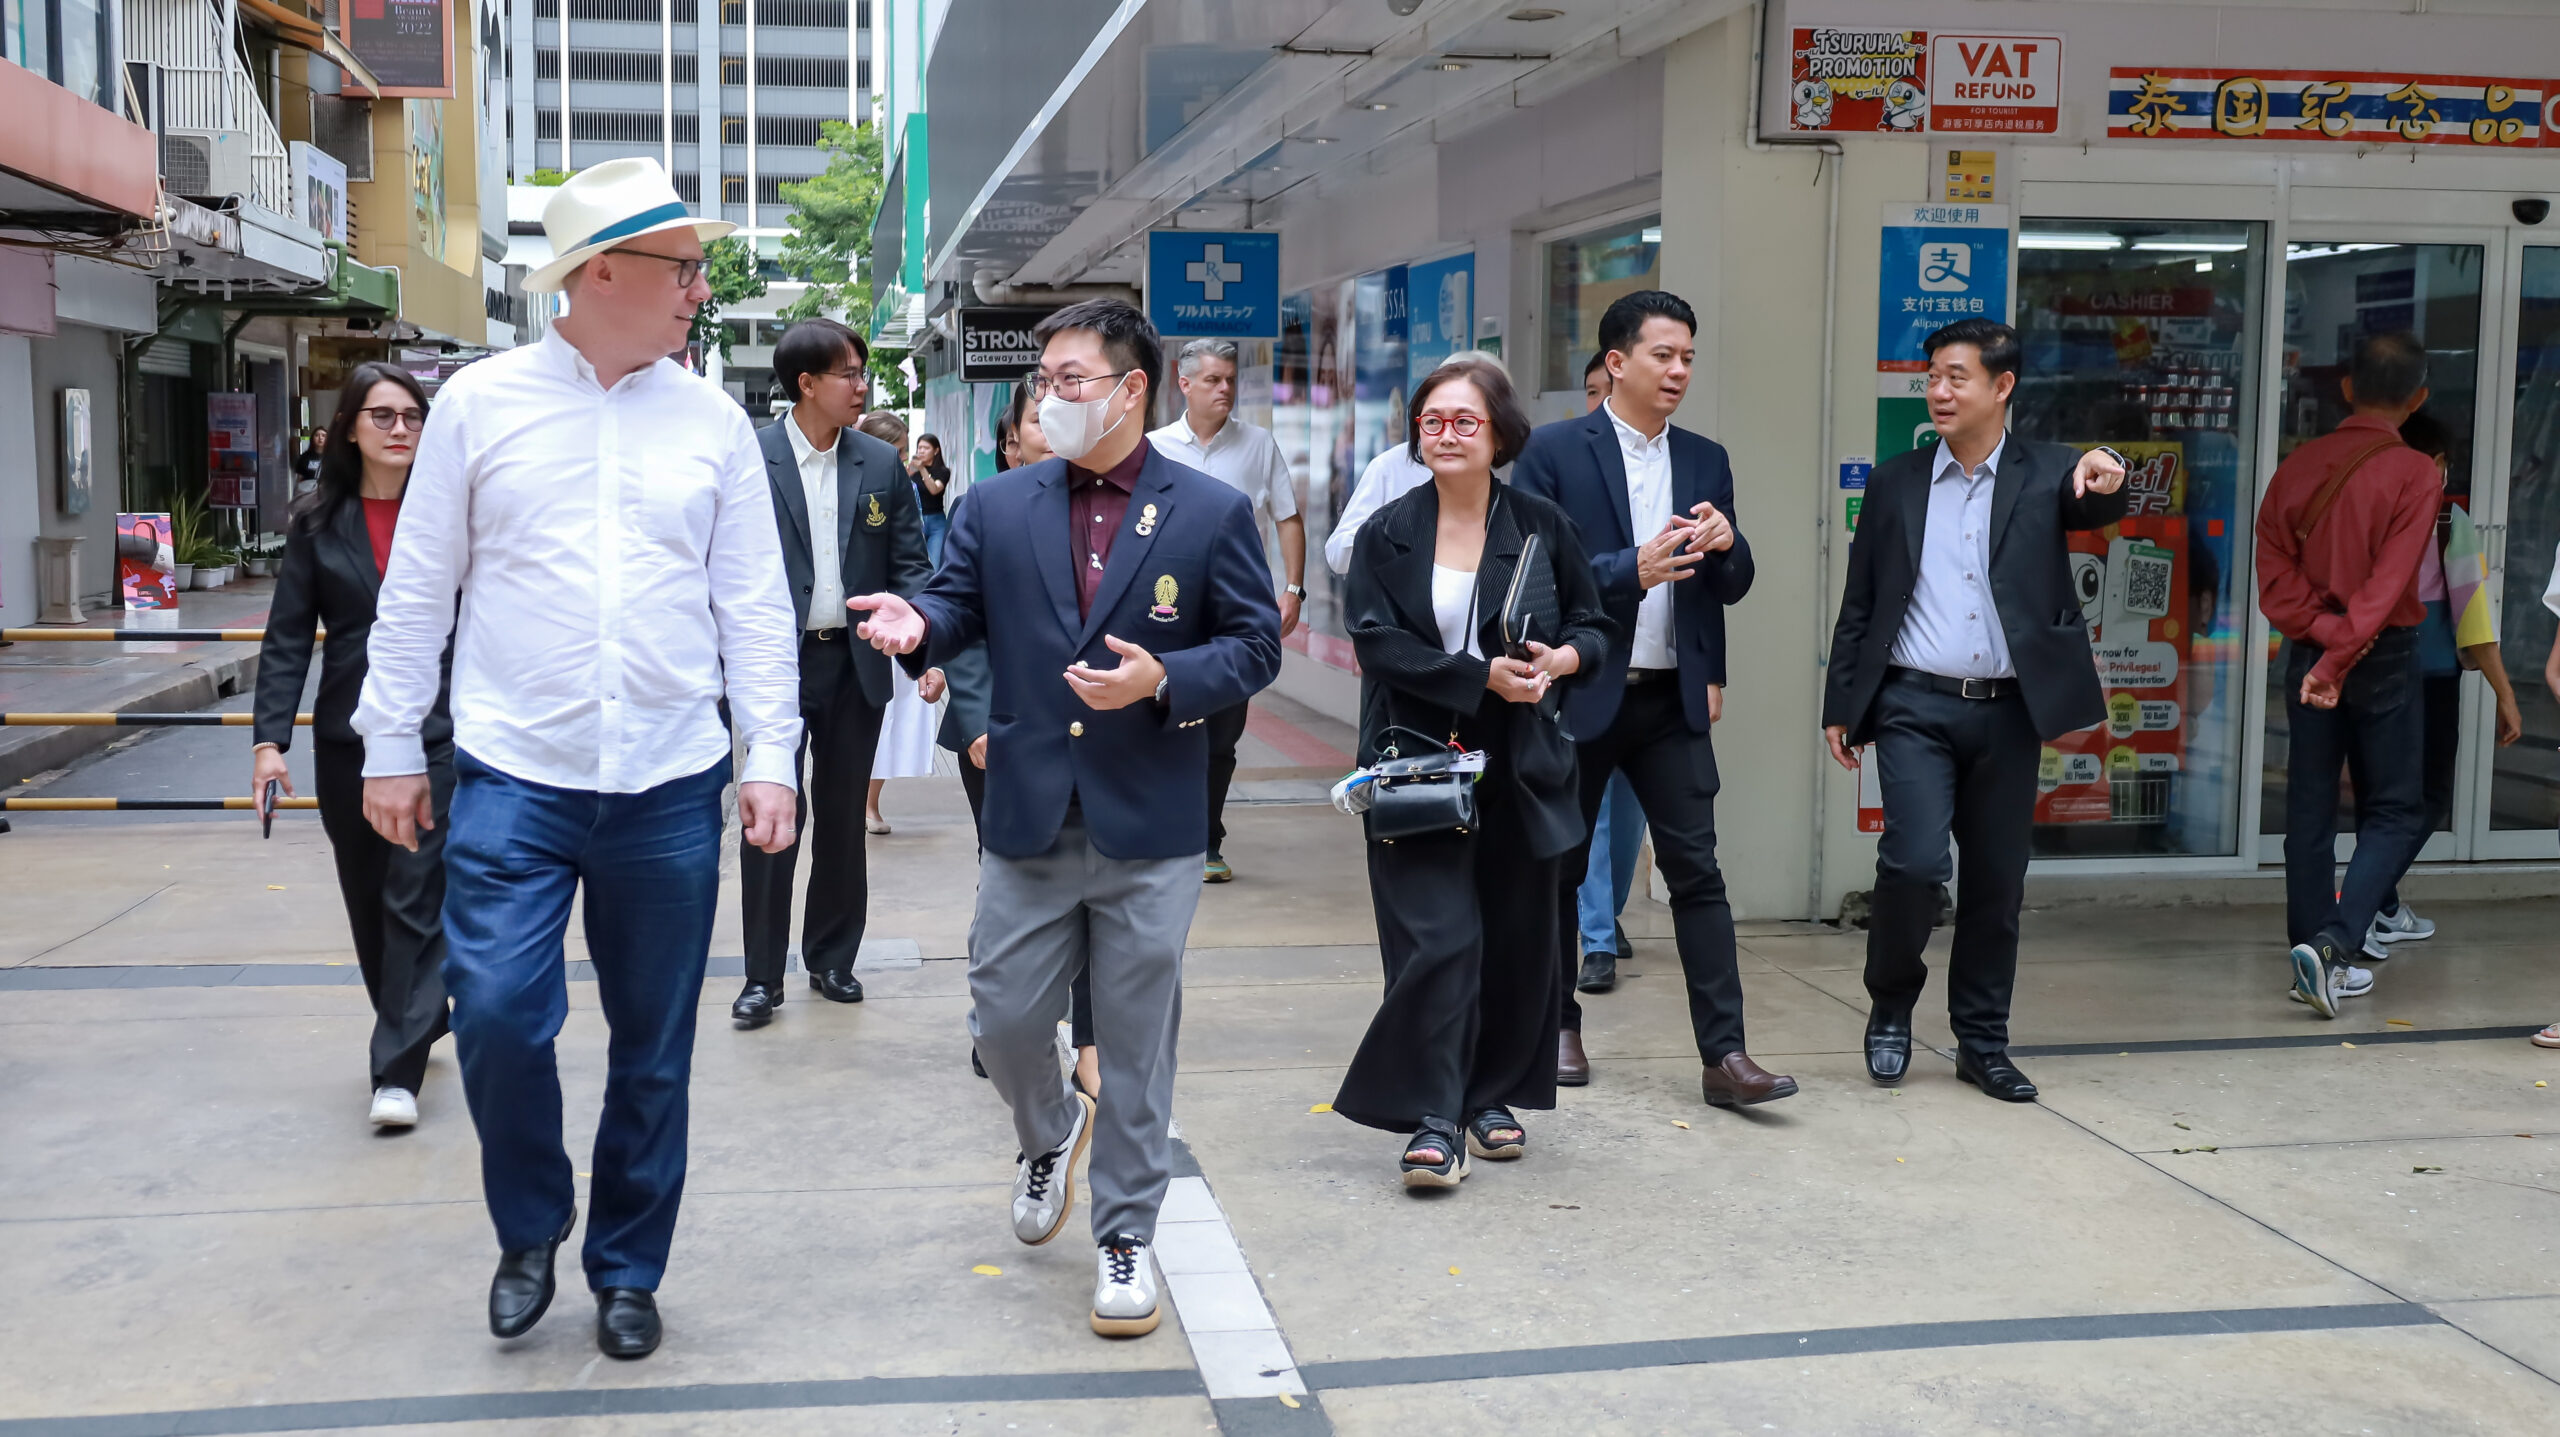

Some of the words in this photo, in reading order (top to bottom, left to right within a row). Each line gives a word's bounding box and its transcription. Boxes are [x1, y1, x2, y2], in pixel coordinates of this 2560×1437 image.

[395, 5, 431, 17] Beauty
[396, 23, 432, 35] 2022
[1816, 33, 1906, 56] TSURUHA
[1957, 42, 2038, 78] VAT
[1808, 57, 1916, 78] PROMOTION
[1954, 82, 2036, 99] REFUND
[1989, 107, 2019, 115] TOURIST
[1914, 207, 1980, 223] 欢迎使用
[1901, 296, 1985, 313] 支付宝钱包
[2090, 293, 2176, 310] CASHIER
[1173, 305, 1256, 318] ツルハドラッグ
[1177, 321, 1253, 332] PHARMACY
[1911, 318, 1945, 330] Alipay
[970, 354, 1014, 364] Gateway
[1017, 354, 1028, 362] to
[2102, 649, 2122, 658] now
[2123, 647, 2139, 658] for
[2109, 662, 2162, 674] Privileges!
[2120, 675, 2167, 685] registration
[2072, 758, 2087, 770] Get
[2113, 753, 2130, 763] Earn
[2149, 757, 2168, 768] Every
[2074, 771, 2095, 781] Points
